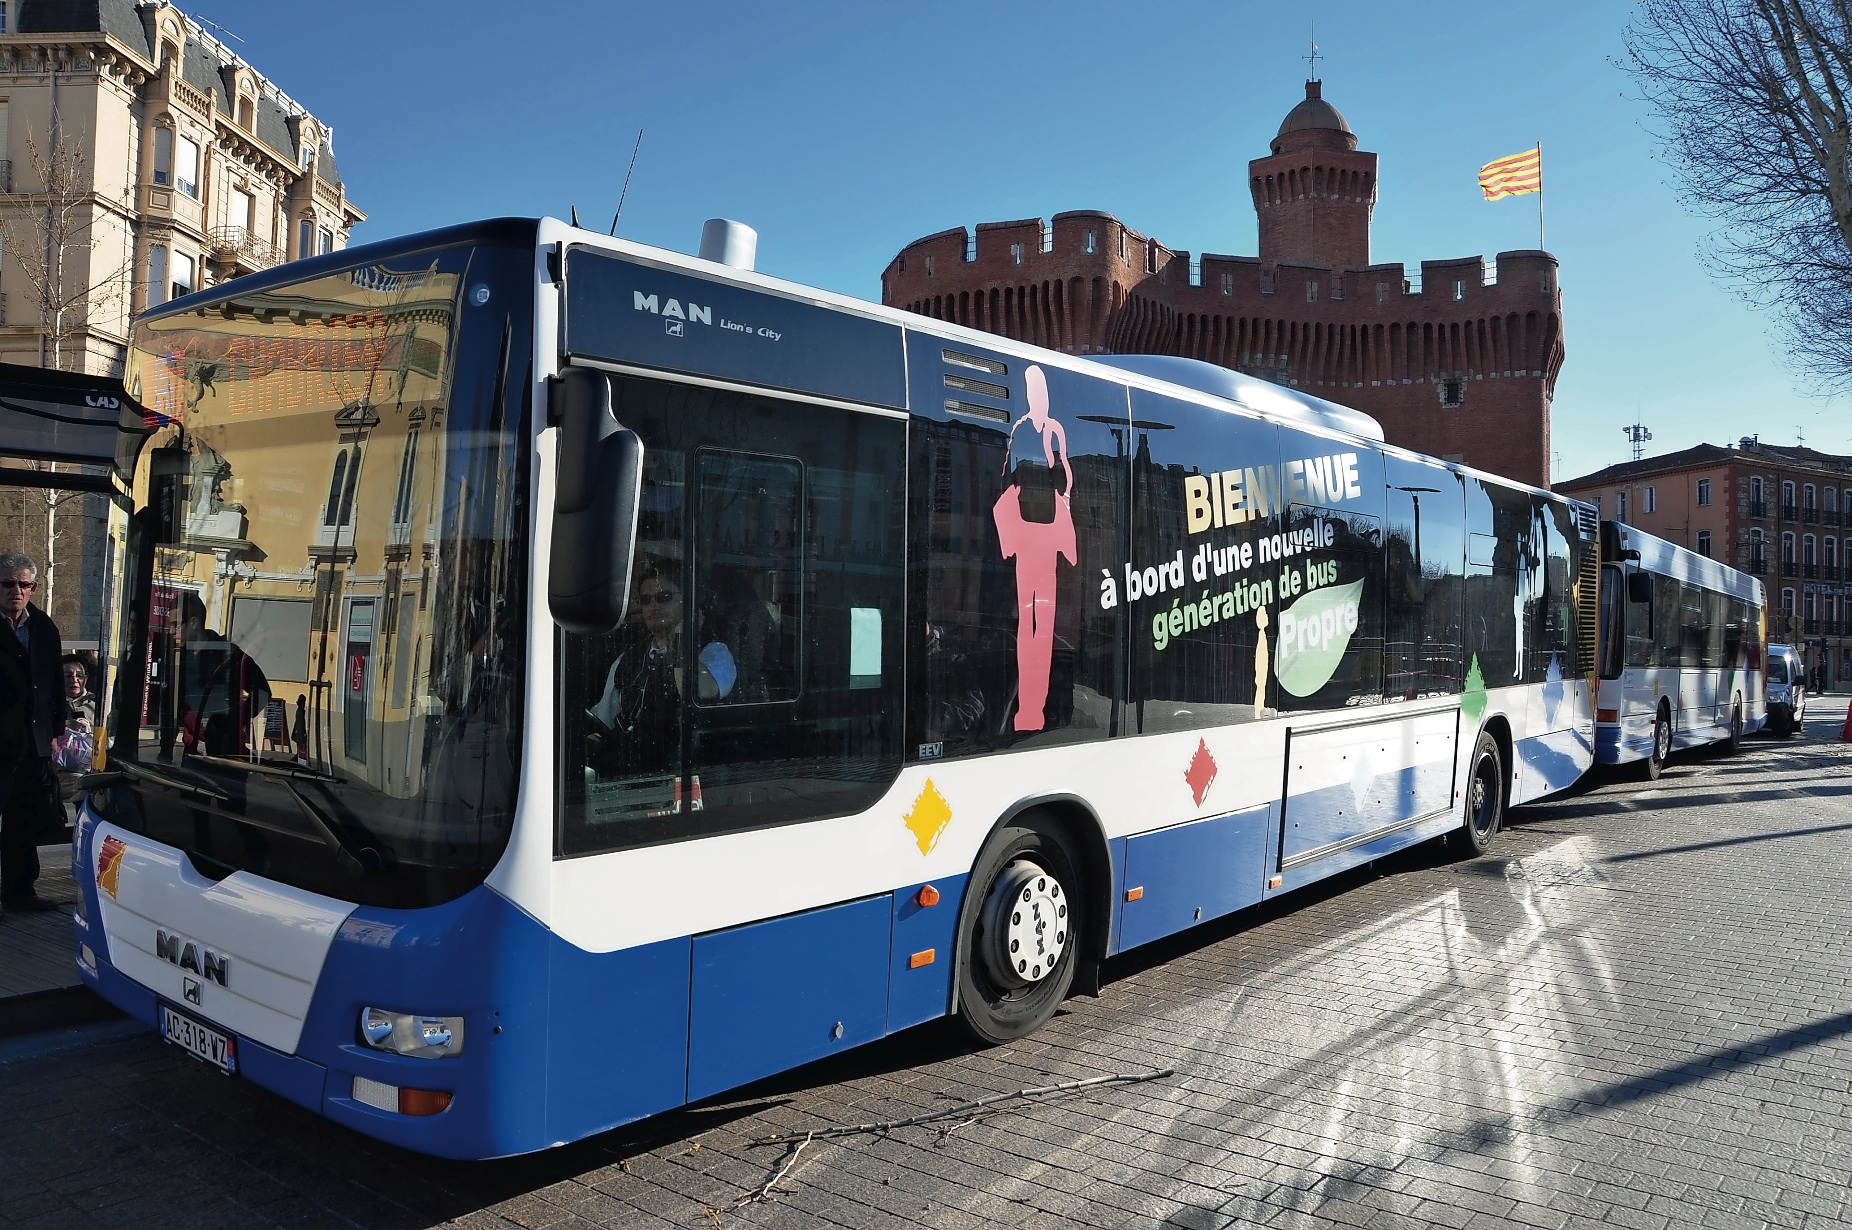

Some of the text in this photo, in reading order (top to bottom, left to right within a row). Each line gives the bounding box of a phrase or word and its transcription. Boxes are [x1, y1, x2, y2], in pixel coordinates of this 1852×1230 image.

[633, 290, 782, 341] MAN Lion's City
[1184, 453, 1362, 535] BIENVENUE
[1100, 517, 1335, 610] à bord d'une nouvelle
[1152, 558, 1338, 652] génération de bus
[1280, 600, 1360, 659] Propre
[919, 744, 940, 757] EEV
[156, 927, 230, 988] MAN
[1032, 902, 1045, 957] MAN
